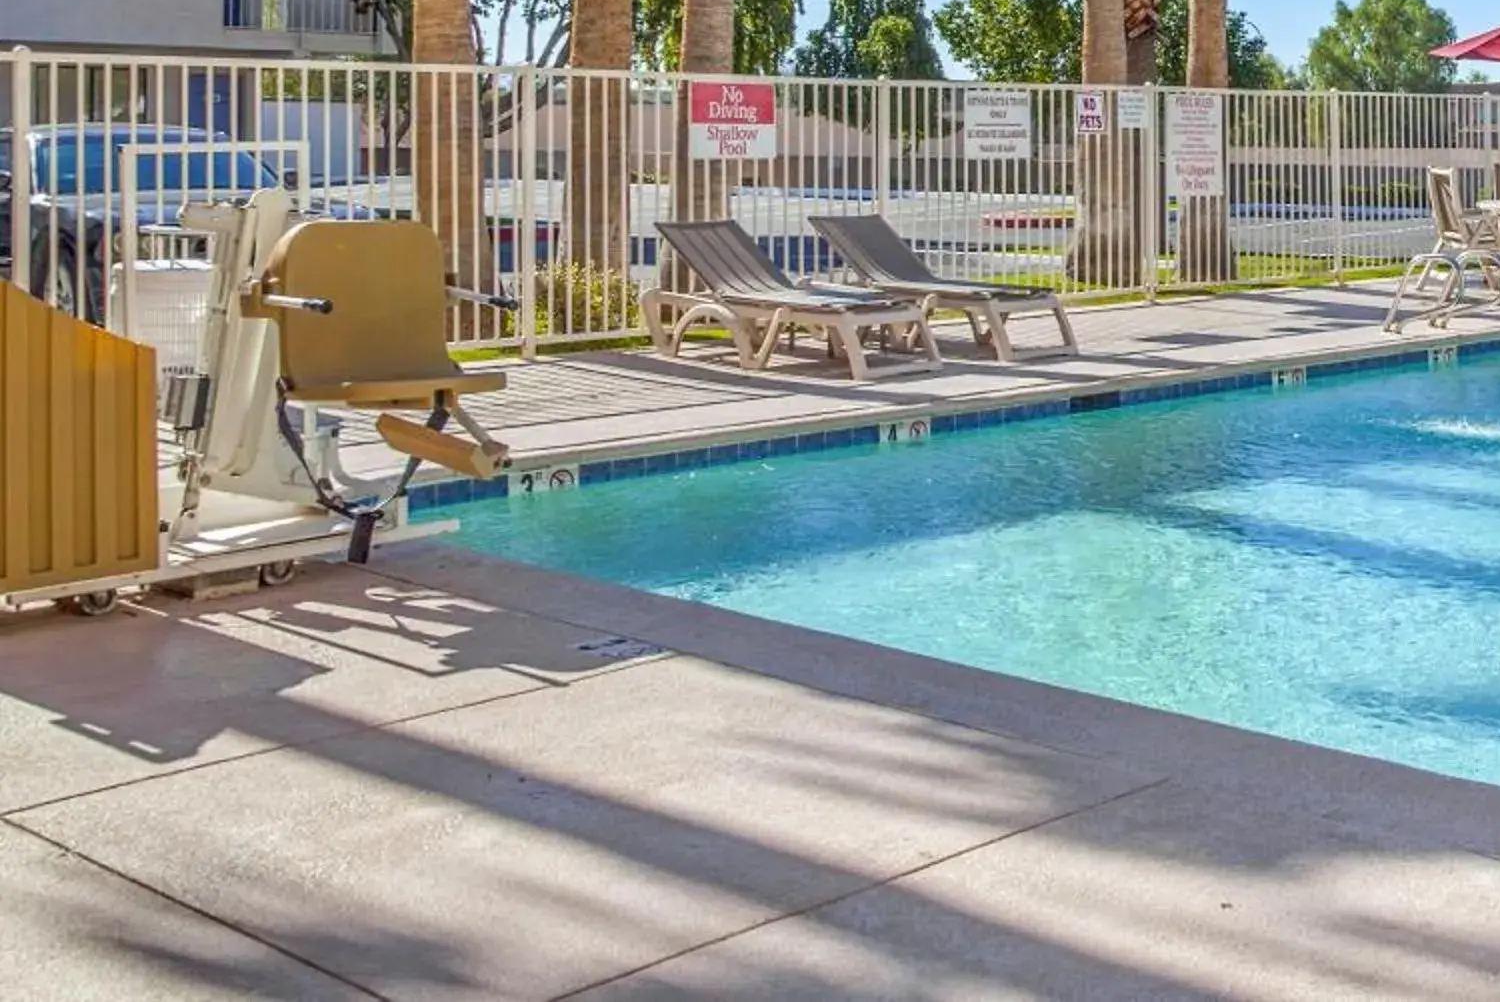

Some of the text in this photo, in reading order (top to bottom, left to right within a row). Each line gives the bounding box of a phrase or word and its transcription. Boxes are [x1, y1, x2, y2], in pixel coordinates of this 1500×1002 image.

[721, 85, 743, 103] No
[709, 101, 757, 123] Diving
[1083, 97, 1097, 111] NO
[1080, 115, 1102, 129] PETS
[706, 125, 759, 141] Shallow
[719, 140, 747, 156] Pool
